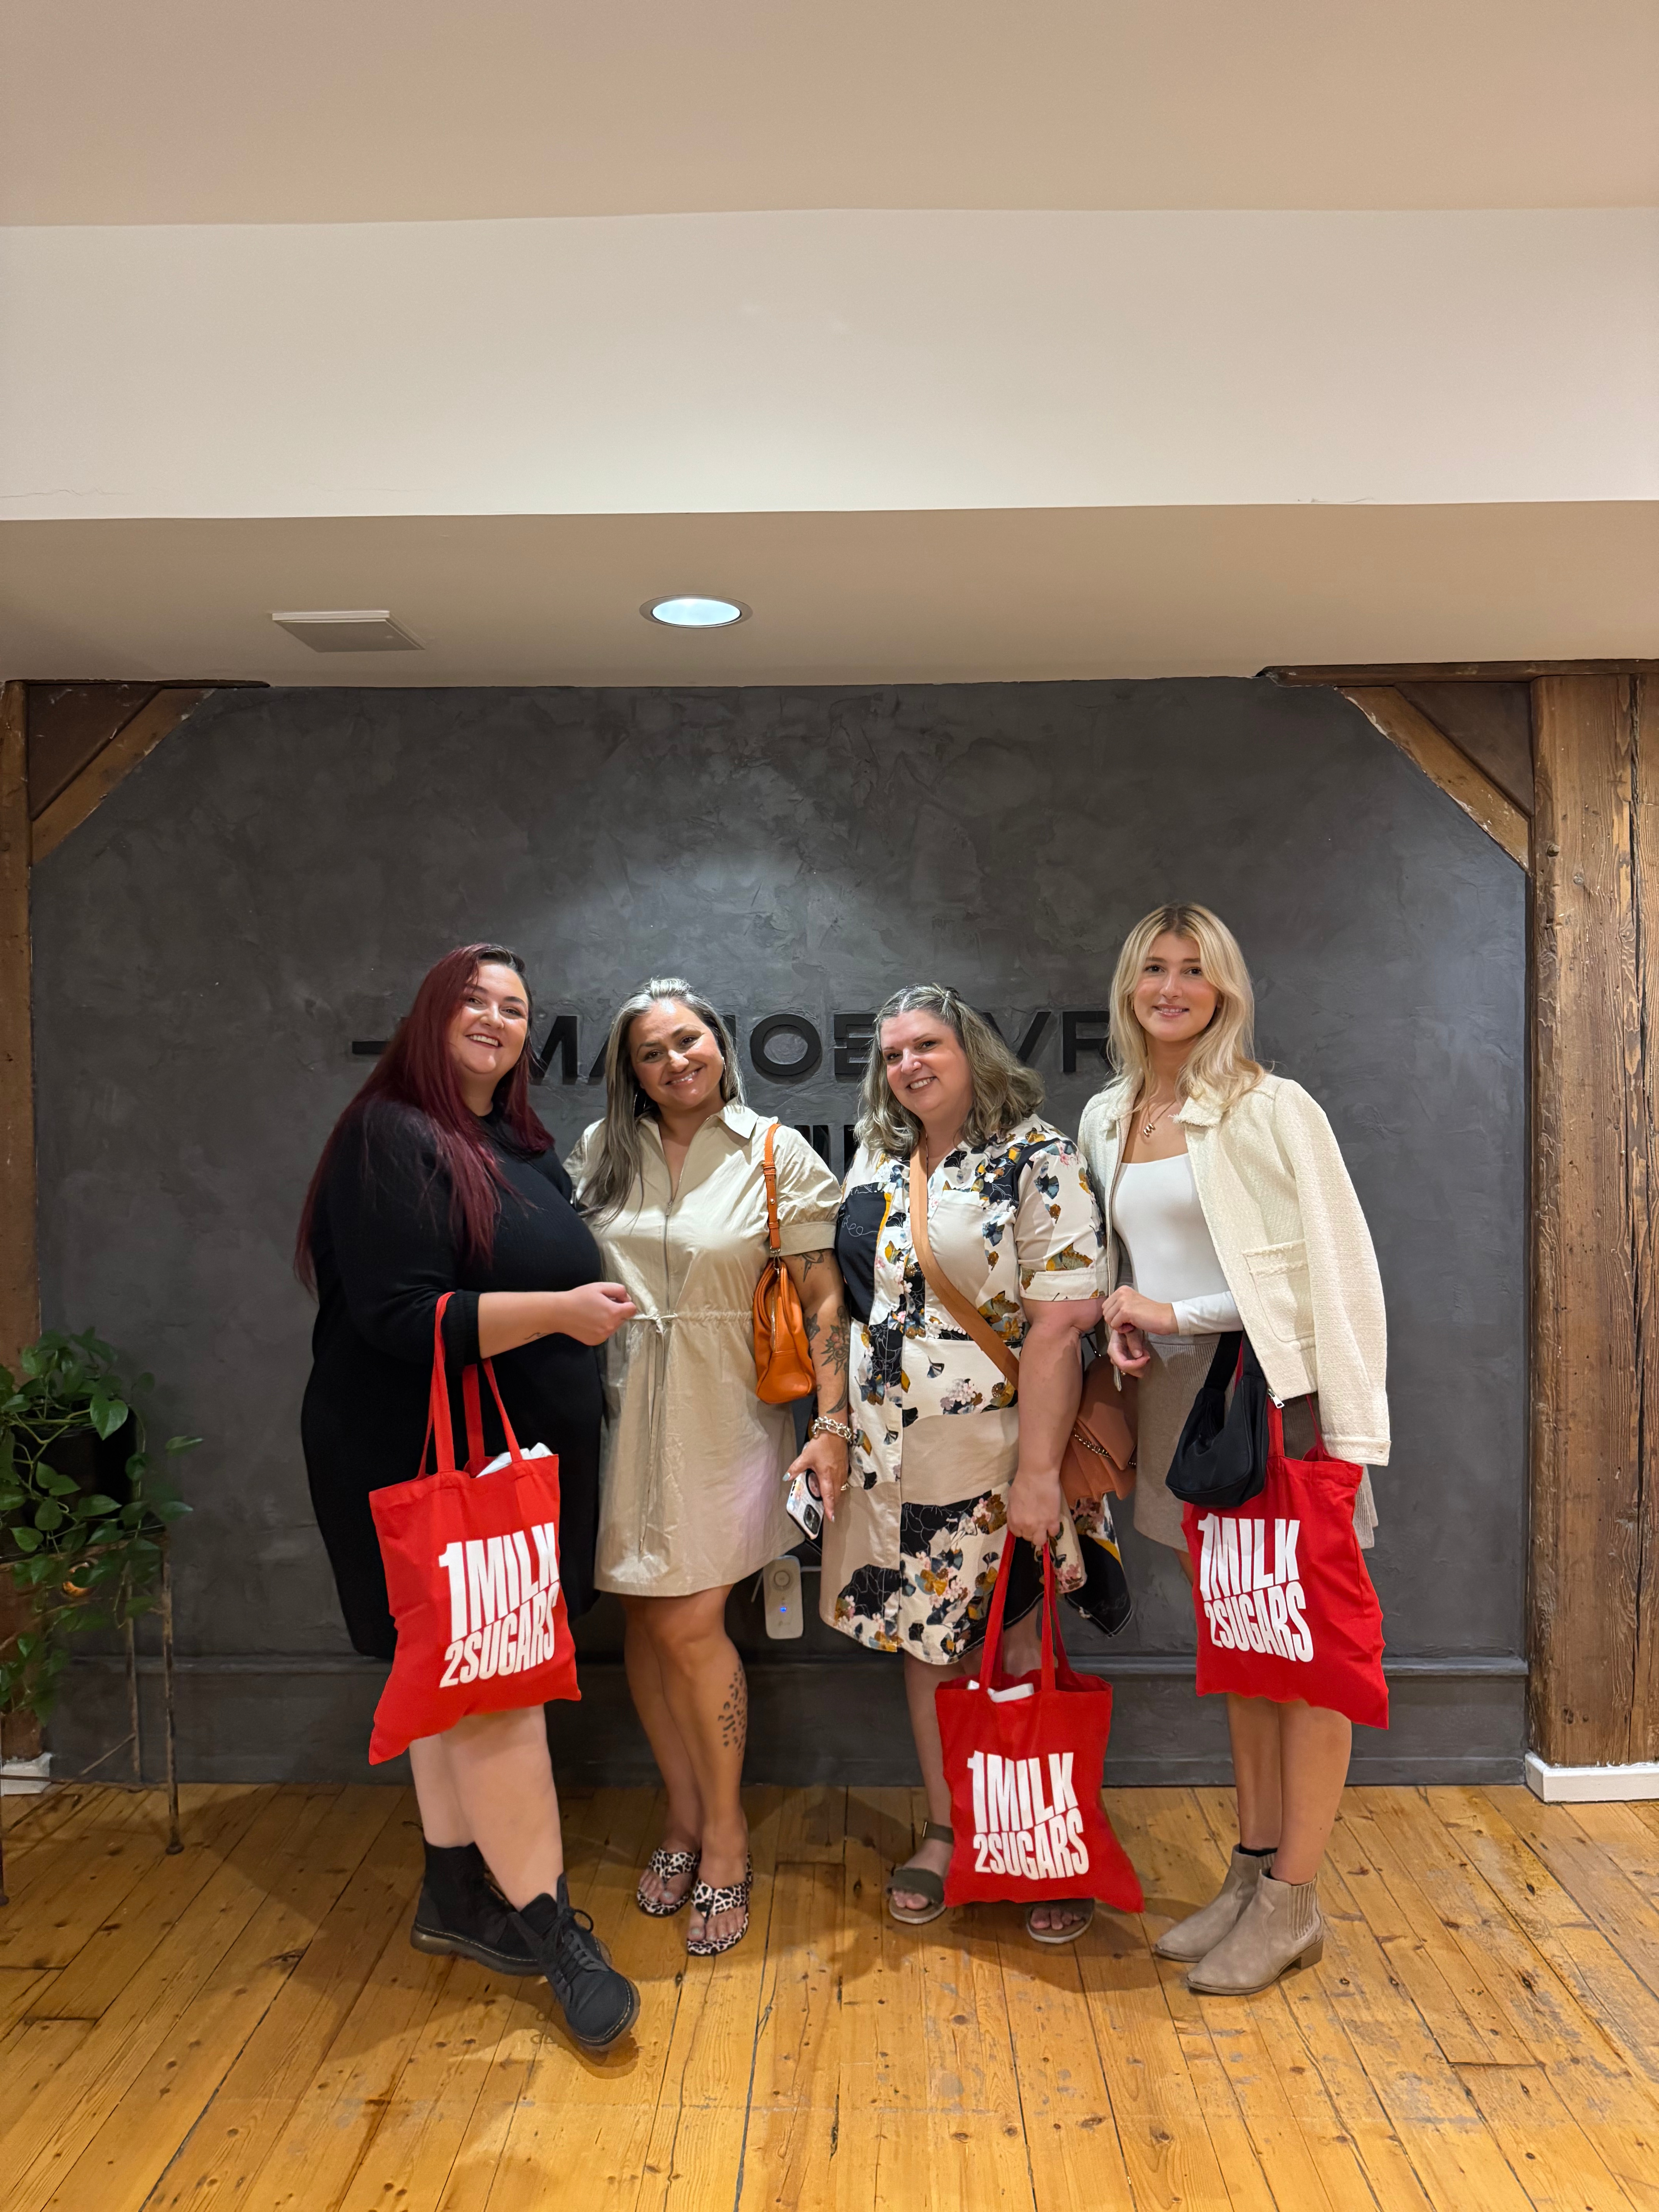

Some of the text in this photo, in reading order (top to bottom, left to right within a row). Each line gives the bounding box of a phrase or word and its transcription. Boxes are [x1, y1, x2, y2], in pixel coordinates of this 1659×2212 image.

[439, 1522, 559, 1642] 1MILK
[1198, 1513, 1300, 1601] 1MILK
[439, 1581, 559, 1687] 2SUGARS
[1204, 1582, 1313, 1662] 2SUGARS
[967, 1750, 1078, 1833] 1MILK
[973, 1808, 1089, 1880] 2SUGARS
